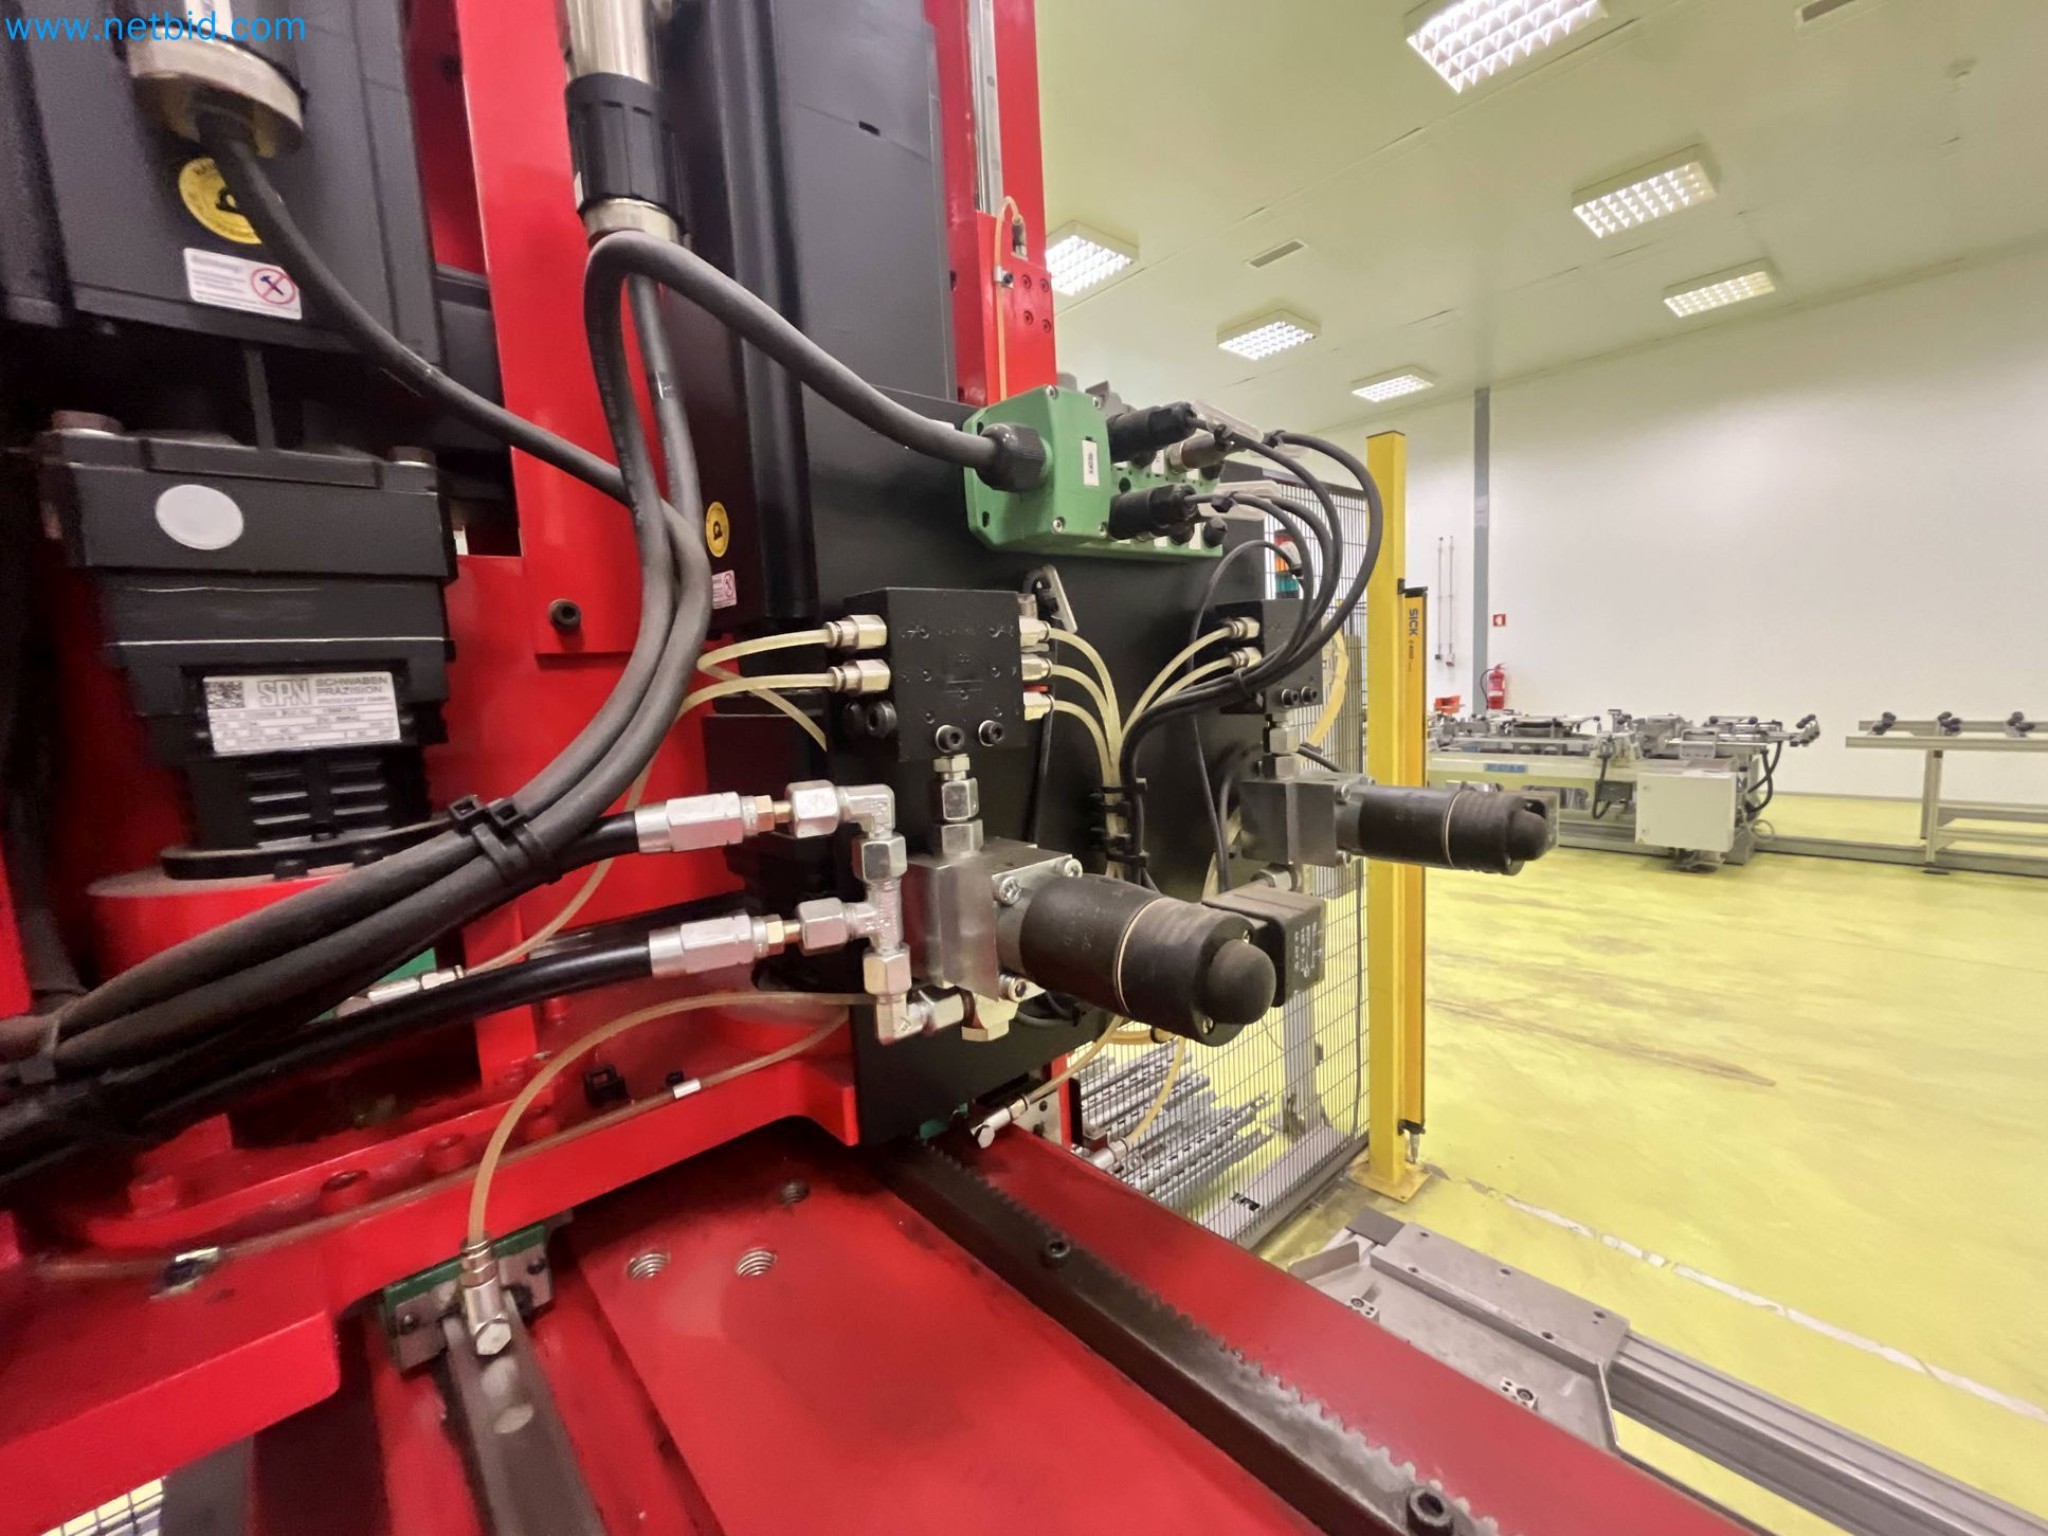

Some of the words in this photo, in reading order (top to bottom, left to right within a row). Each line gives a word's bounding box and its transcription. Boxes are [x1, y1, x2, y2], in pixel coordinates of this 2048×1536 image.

[1409, 608, 1418, 635] SICK
[257, 679, 312, 707] SPN
[315, 676, 389, 687] SCHWABEN
